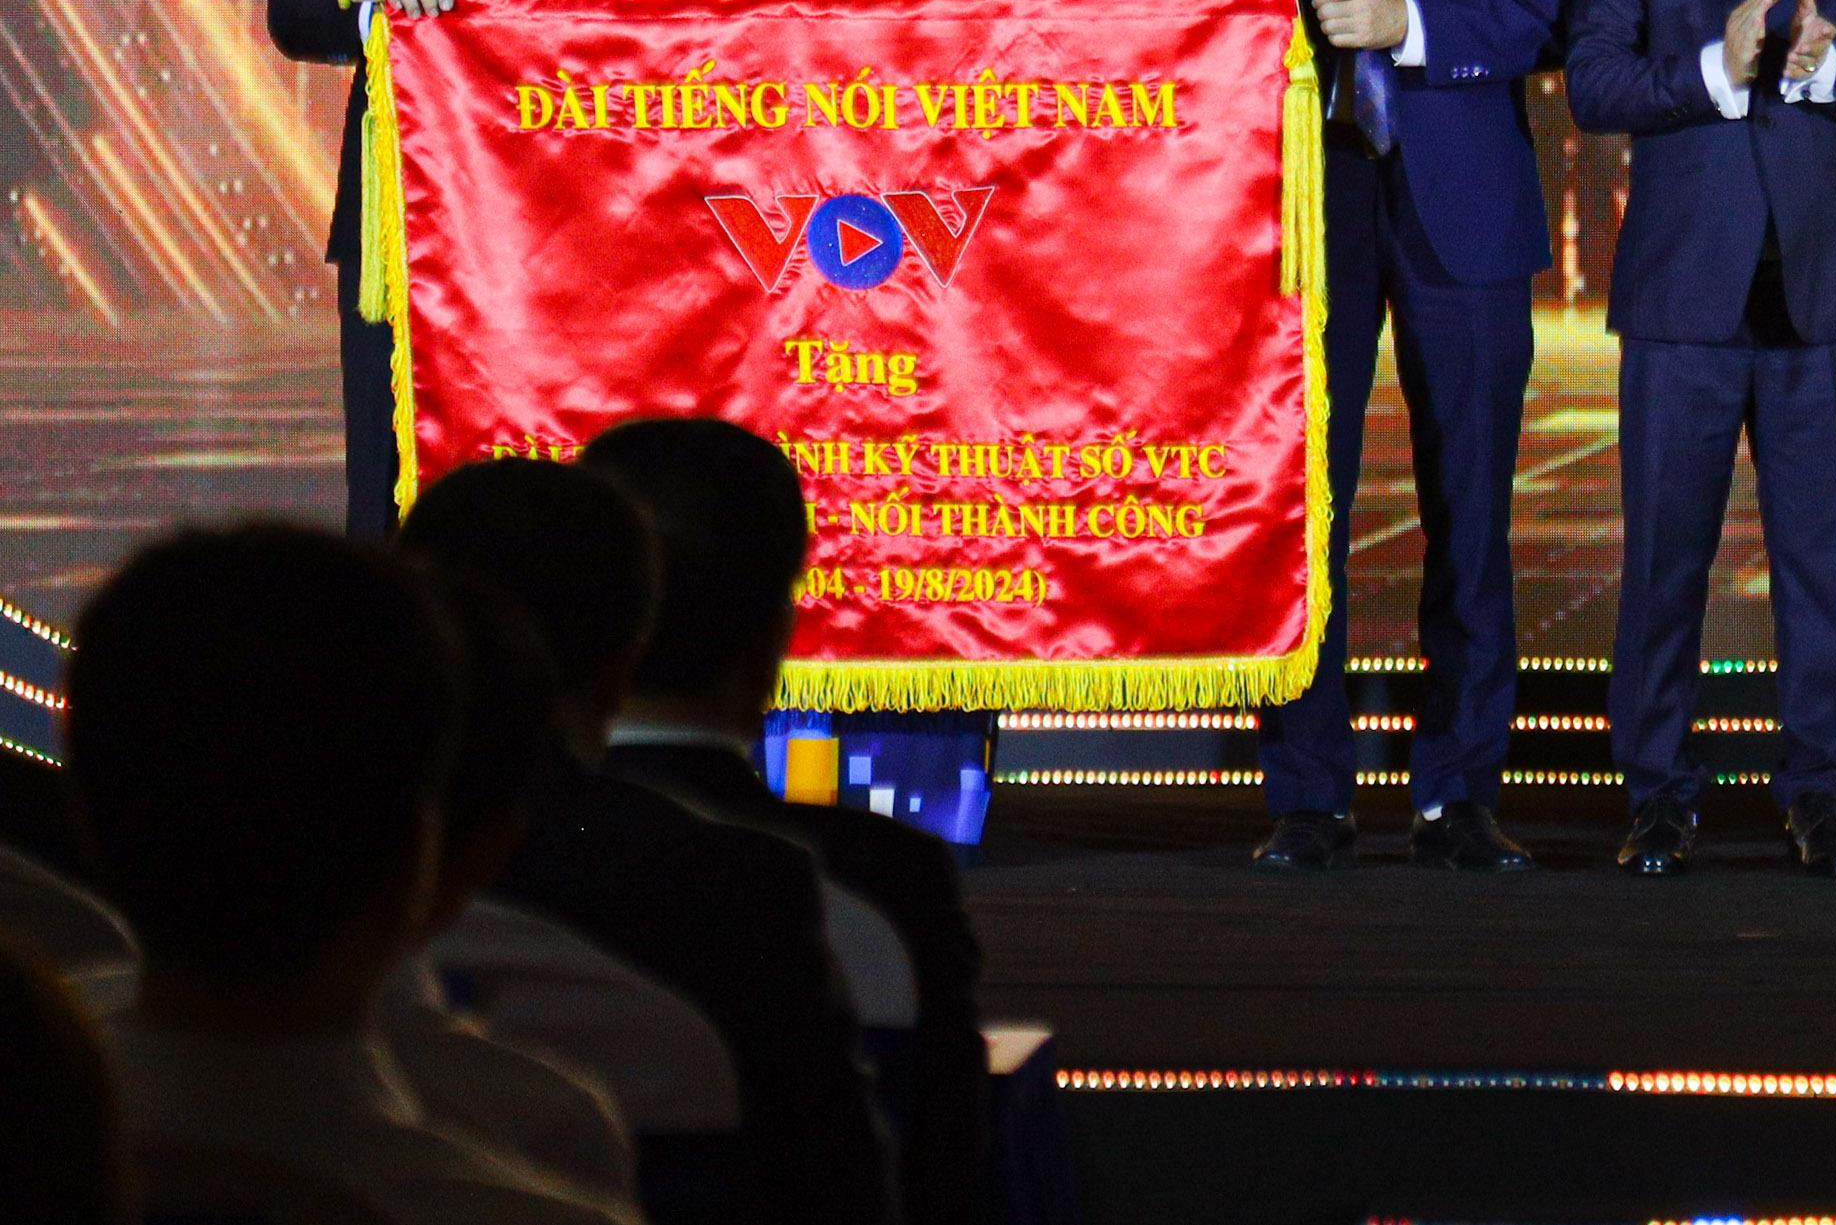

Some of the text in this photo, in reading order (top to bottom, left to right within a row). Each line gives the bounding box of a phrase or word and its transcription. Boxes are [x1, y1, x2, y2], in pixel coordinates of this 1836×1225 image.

[516, 60, 1177, 139] ĐÀI TIẾNG NÓI VIỆT NAM
[785, 339, 918, 396] Tặng
[778, 430, 1226, 485] ÌNH KỸ THUẬT SỐ VTC
[850, 487, 922, 536] NỐI
[933, 493, 1076, 536] THÀNH
[1088, 494, 1205, 537] CÔNG
[879, 568, 1047, 604] 19/8/2024)
